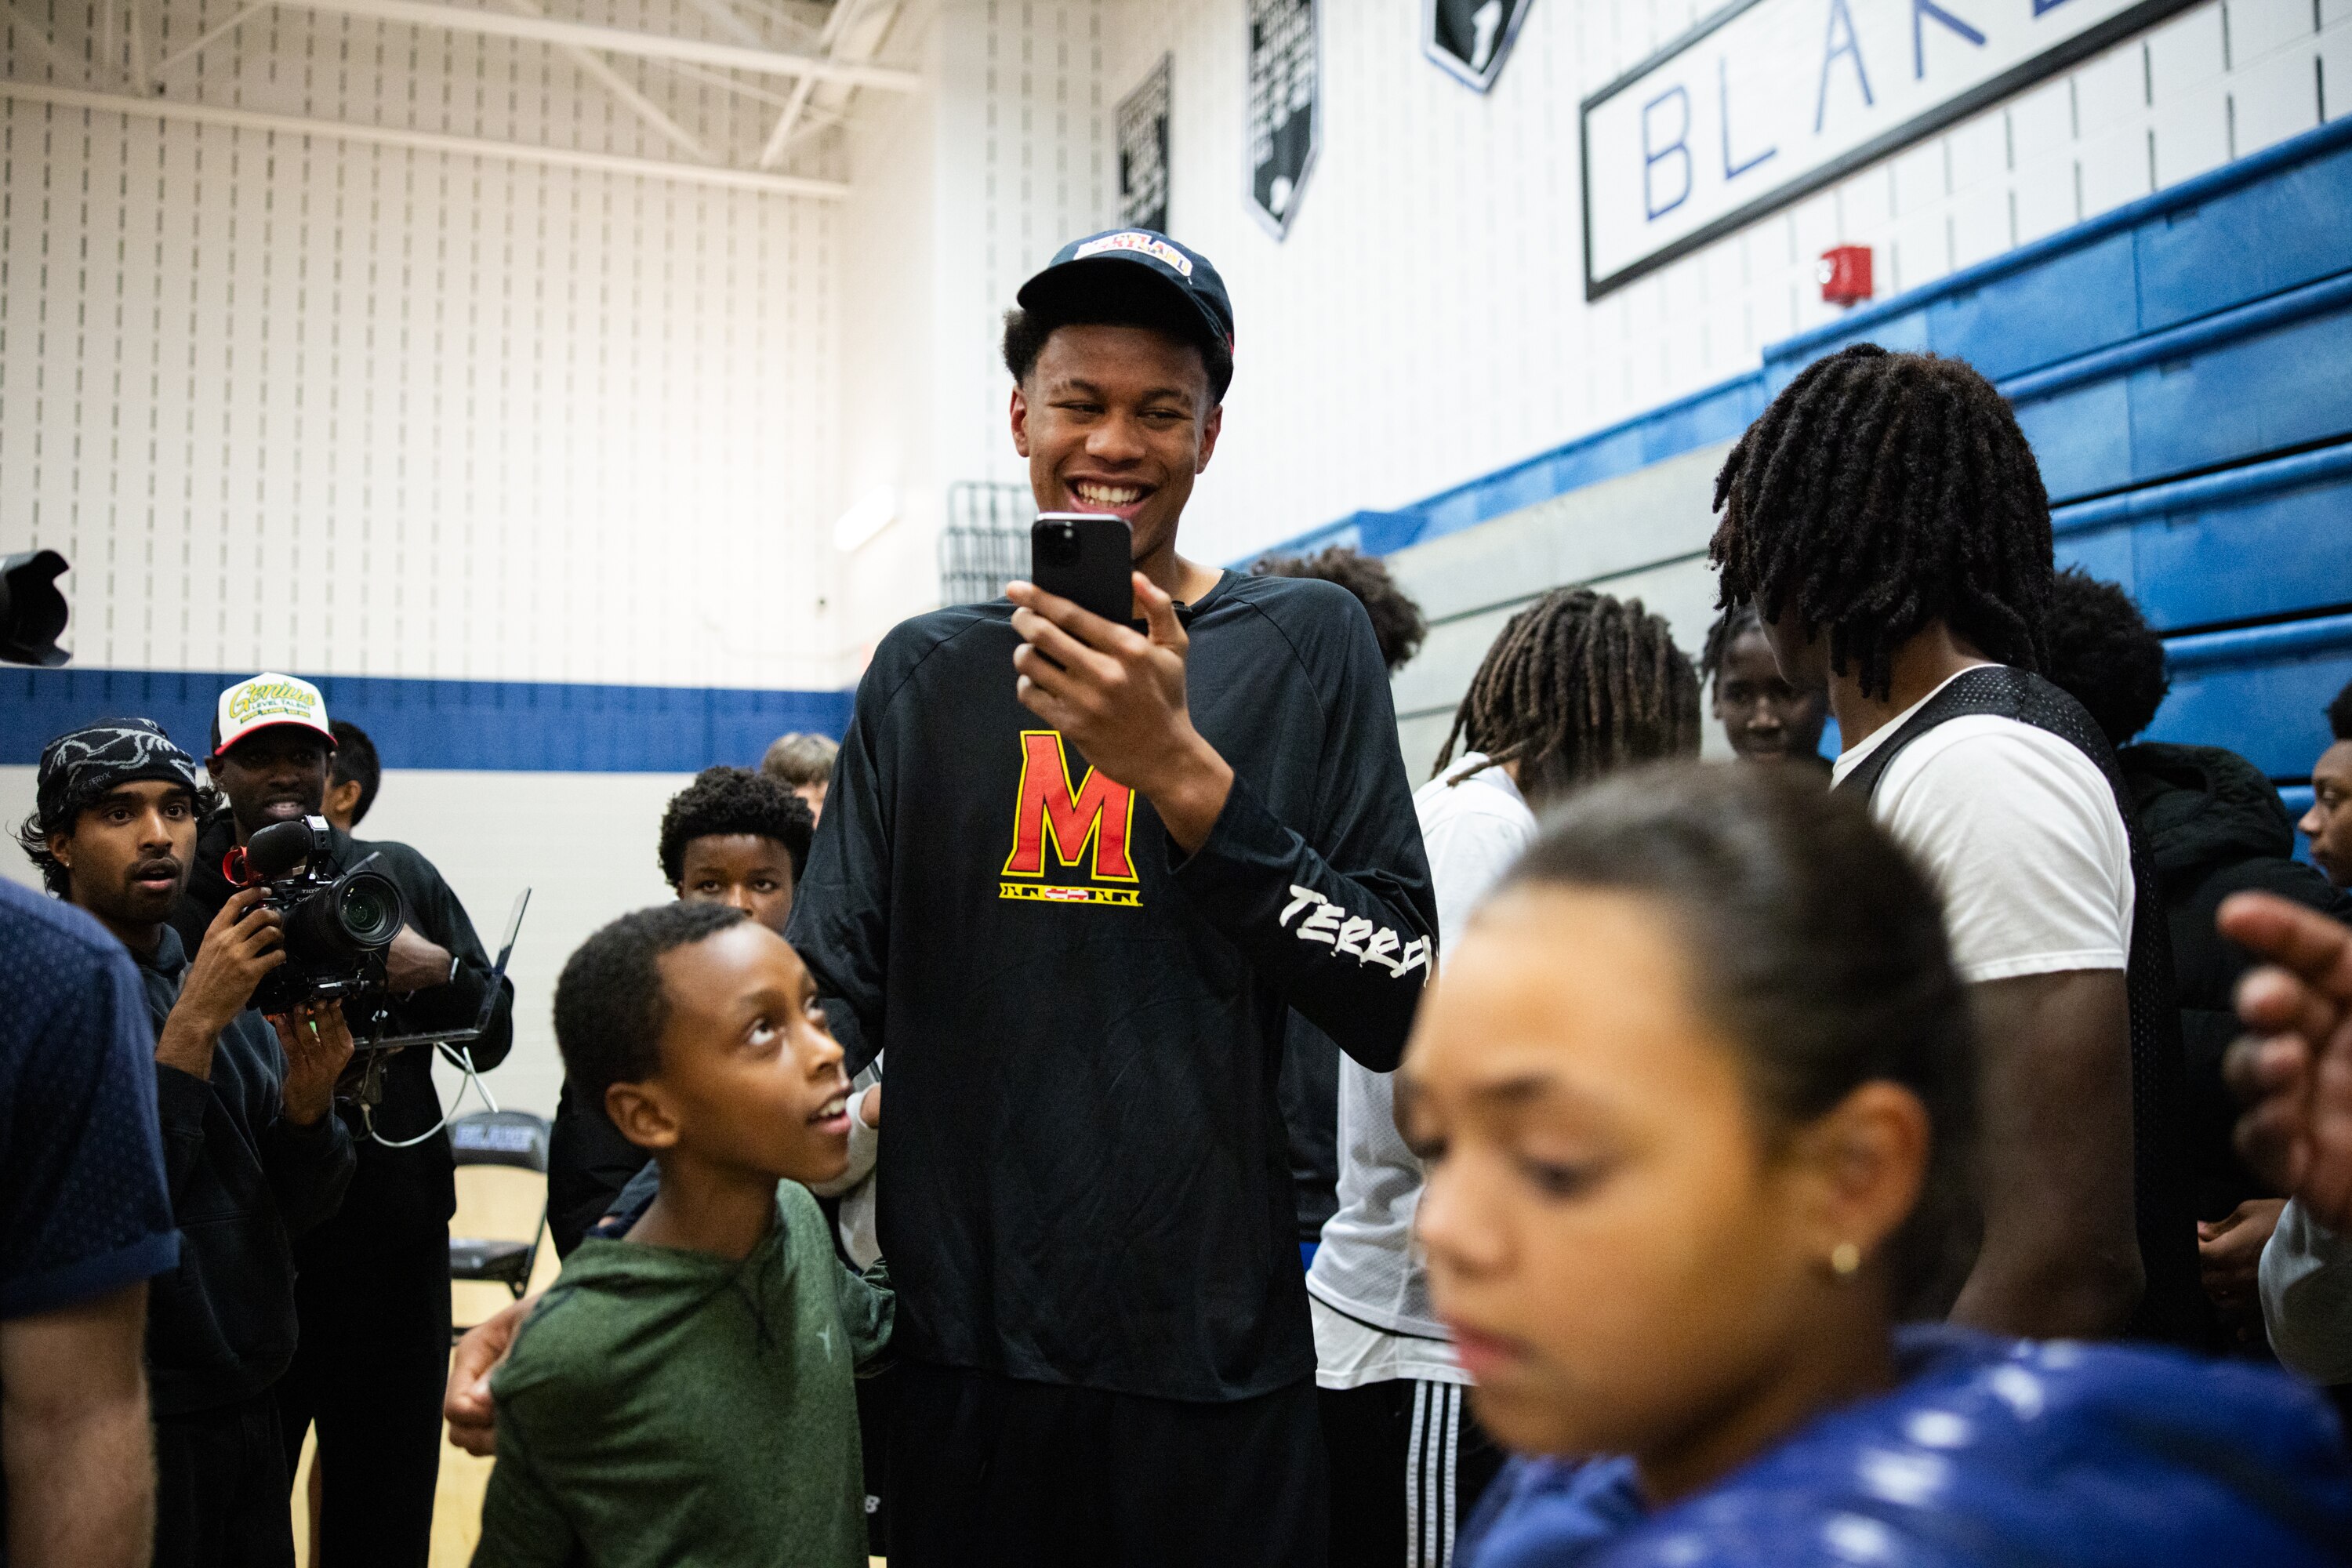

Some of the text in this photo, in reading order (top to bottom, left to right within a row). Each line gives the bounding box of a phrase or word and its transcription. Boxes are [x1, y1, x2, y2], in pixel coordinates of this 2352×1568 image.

[1642, 0, 2070, 221] BLA
[1075, 232, 1192, 276] RYLAND
[229, 681, 316, 719] Genius
[252, 699, 277, 710] LEVEL
[1001, 731, 1139, 883] M
[1279, 884, 1439, 988] TERRA
